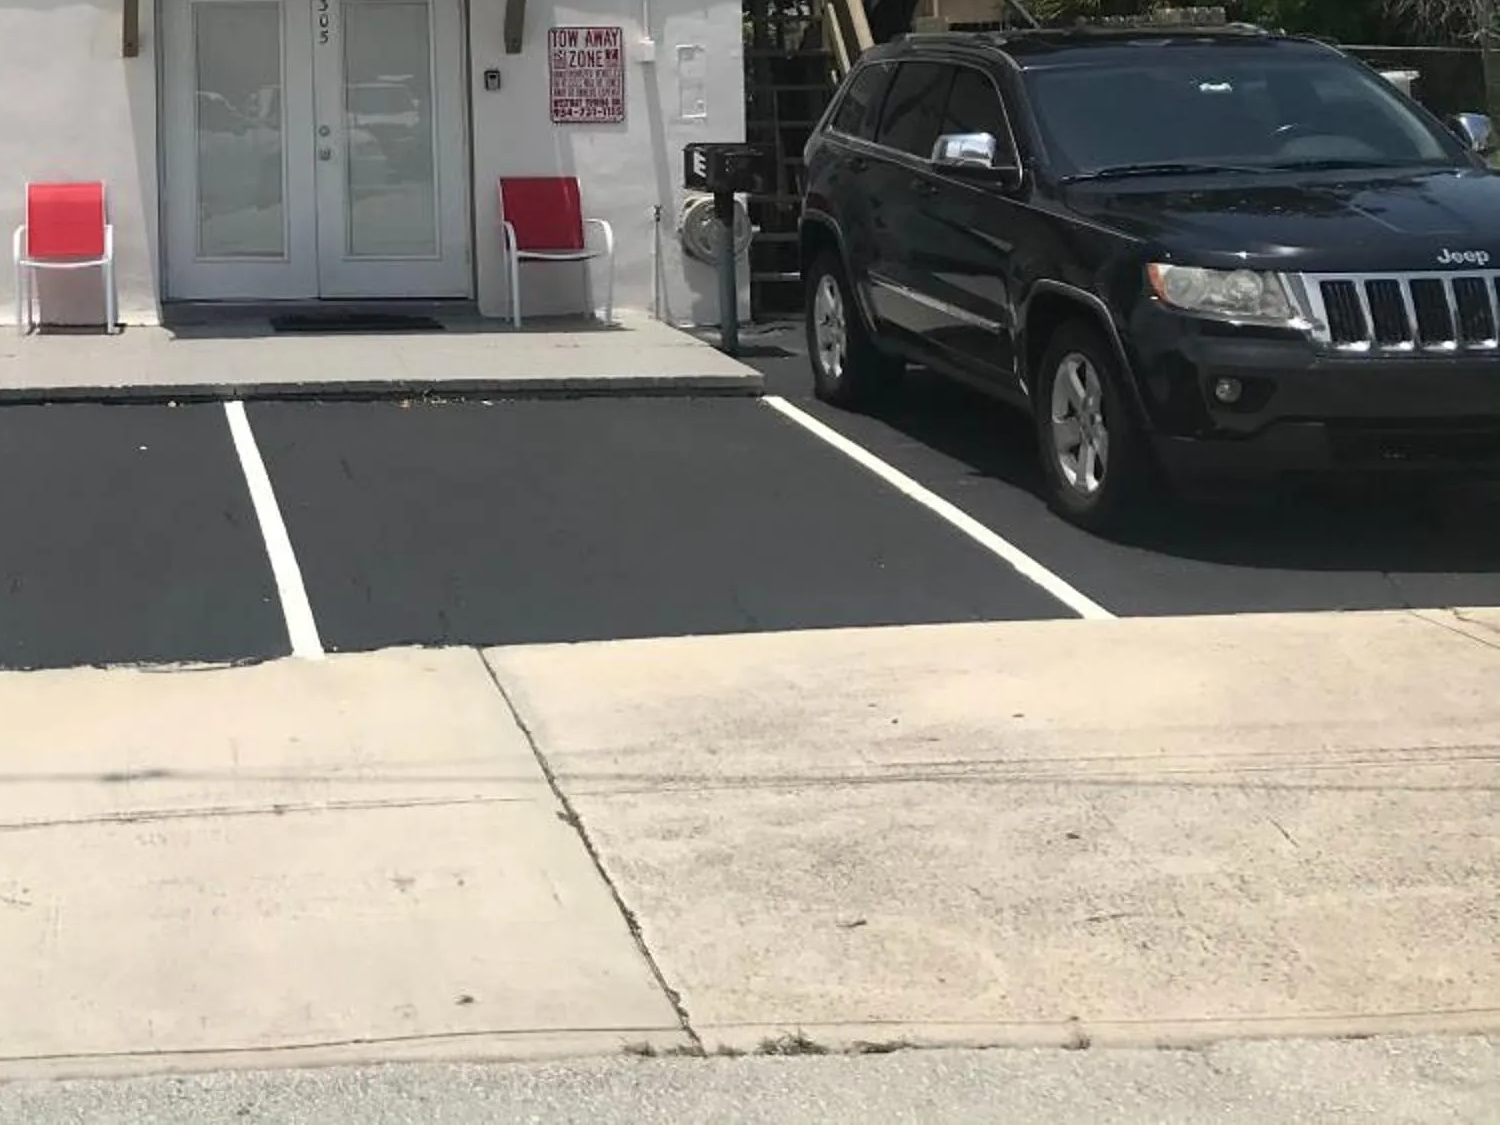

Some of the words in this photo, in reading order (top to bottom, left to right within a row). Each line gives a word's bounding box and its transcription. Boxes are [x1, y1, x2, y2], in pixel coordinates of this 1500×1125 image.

[551, 30, 578, 47] TOW
[585, 30, 618, 47] AWAY
[569, 50, 604, 68] ZONE
[1437, 247, 1490, 266] Jeep
